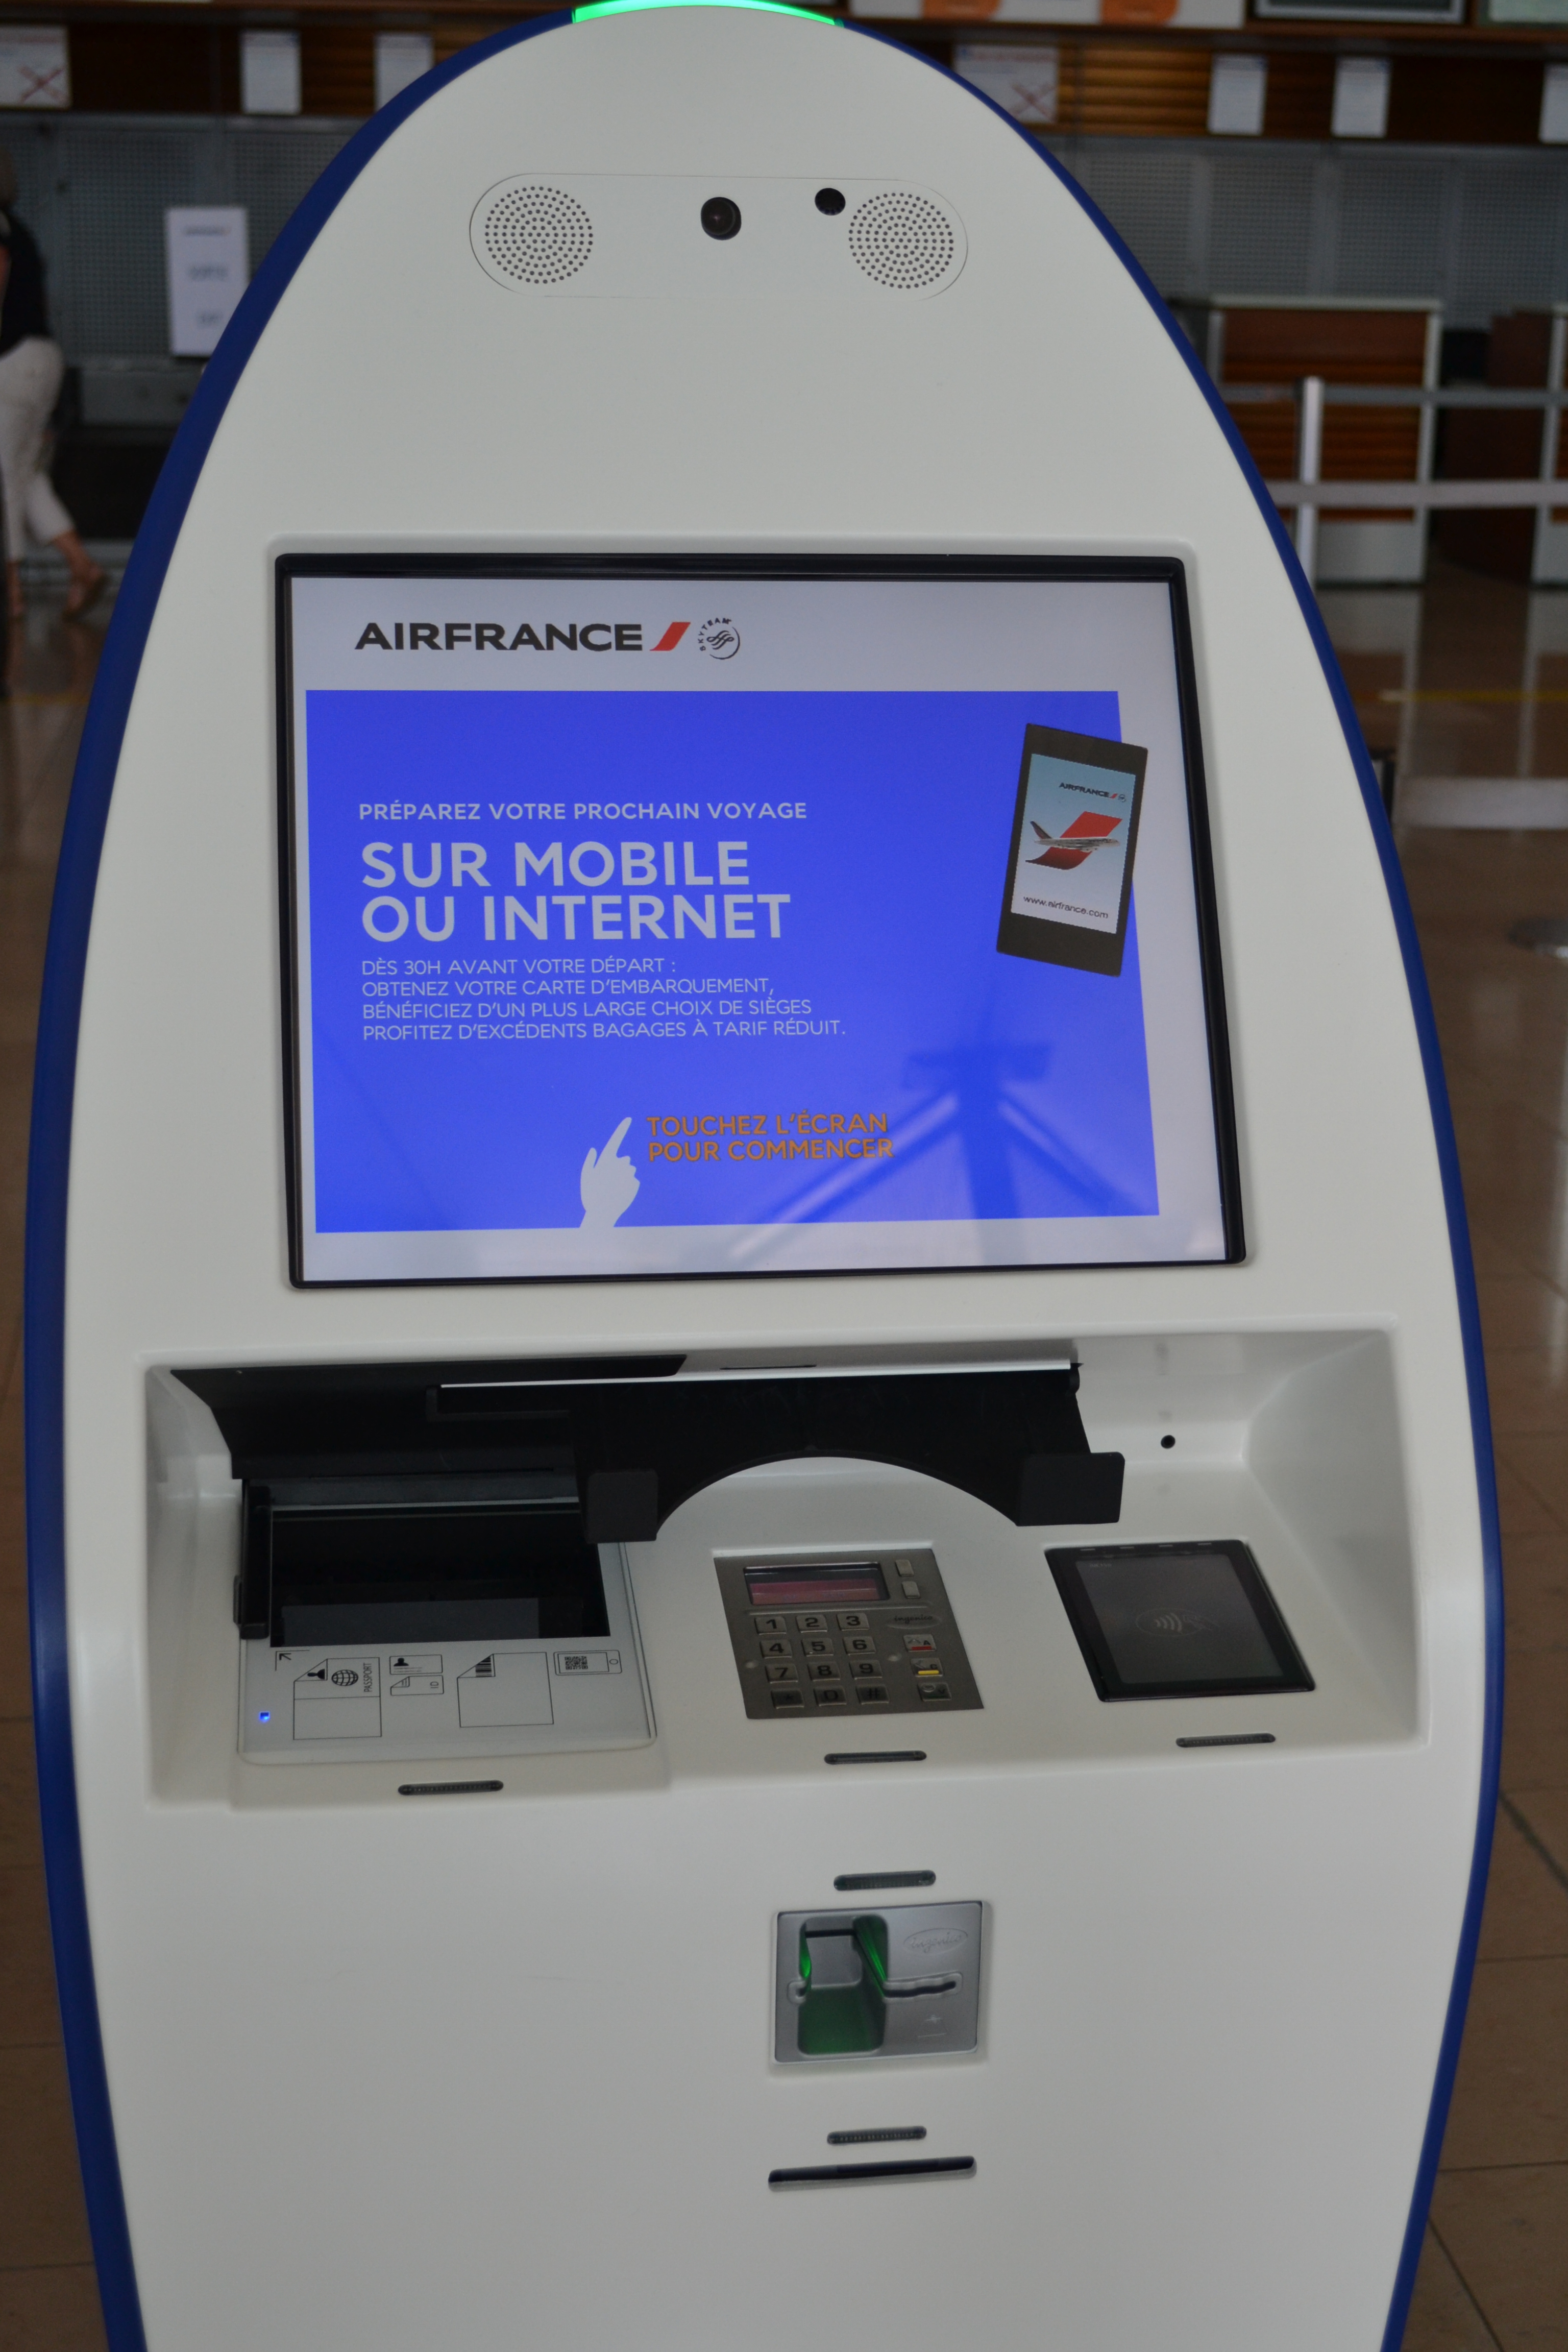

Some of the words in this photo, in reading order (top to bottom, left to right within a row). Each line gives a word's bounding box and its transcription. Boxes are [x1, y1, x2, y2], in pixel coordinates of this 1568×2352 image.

[355, 622, 643, 652] AIRFRANCE
[1059, 782, 1110, 798] AIRFRANCE
[359, 799, 480, 820] PRÉPAREZ
[488, 803, 566, 820] VOTRE
[574, 803, 699, 819] PROCHAIN
[706, 803, 806, 819] VOYAGE
[362, 842, 491, 888] SUR
[514, 841, 749, 887] MOBILE
[362, 895, 455, 942] OU
[484, 894, 791, 940] INTERNET
[1023, 896, 1109, 919] www.airfrance.com
[362, 957, 398, 975] DÈS
[404, 960, 440, 975] 30H
[447, 959, 518, 975] AVANT
[523, 959, 585, 974] VOTRE
[591, 955, 665, 973] DÉPART
[362, 981, 449, 997] OBTENEZ
[455, 980, 517, 996] VOTRE
[522, 980, 585, 995] CARTE
[363, 1000, 472, 1019] BÉNÉFICIEZ
[531, 1002, 577, 1017] PLUS
[583, 1001, 646, 1016] LARGE
[651, 1001, 713, 1016] CHOIX
[719, 1000, 743, 1015] DE
[749, 997, 812, 1015] SIÈGES
[363, 1025, 452, 1040] PROFITEZ
[593, 1022, 687, 1038] BAGAGES
[692, 1019, 708, 1036] À
[713, 1021, 767, 1036] TARIF
[773, 1017, 845, 1035] RÉDUIT.
[646, 1115, 767, 1136] TOUCHEZ
[649, 1141, 720, 1162] POUR
[727, 1138, 893, 1161] COMMENCER
[765, 1618, 778, 1629] 1
[804, 1617, 820, 1628] 2
[846, 1616, 861, 1627] 3
[894, 1614, 933, 1623] ingenico
[769, 1642, 785, 1654] 4
[811, 1641, 826, 1652] 5
[852, 1639, 867, 1650] 6
[363, 1663, 373, 1692] PASSPORT
[774, 1667, 789, 1679] 7
[817, 1665, 832, 1676] 8
[859, 1663, 874, 1674] 9
